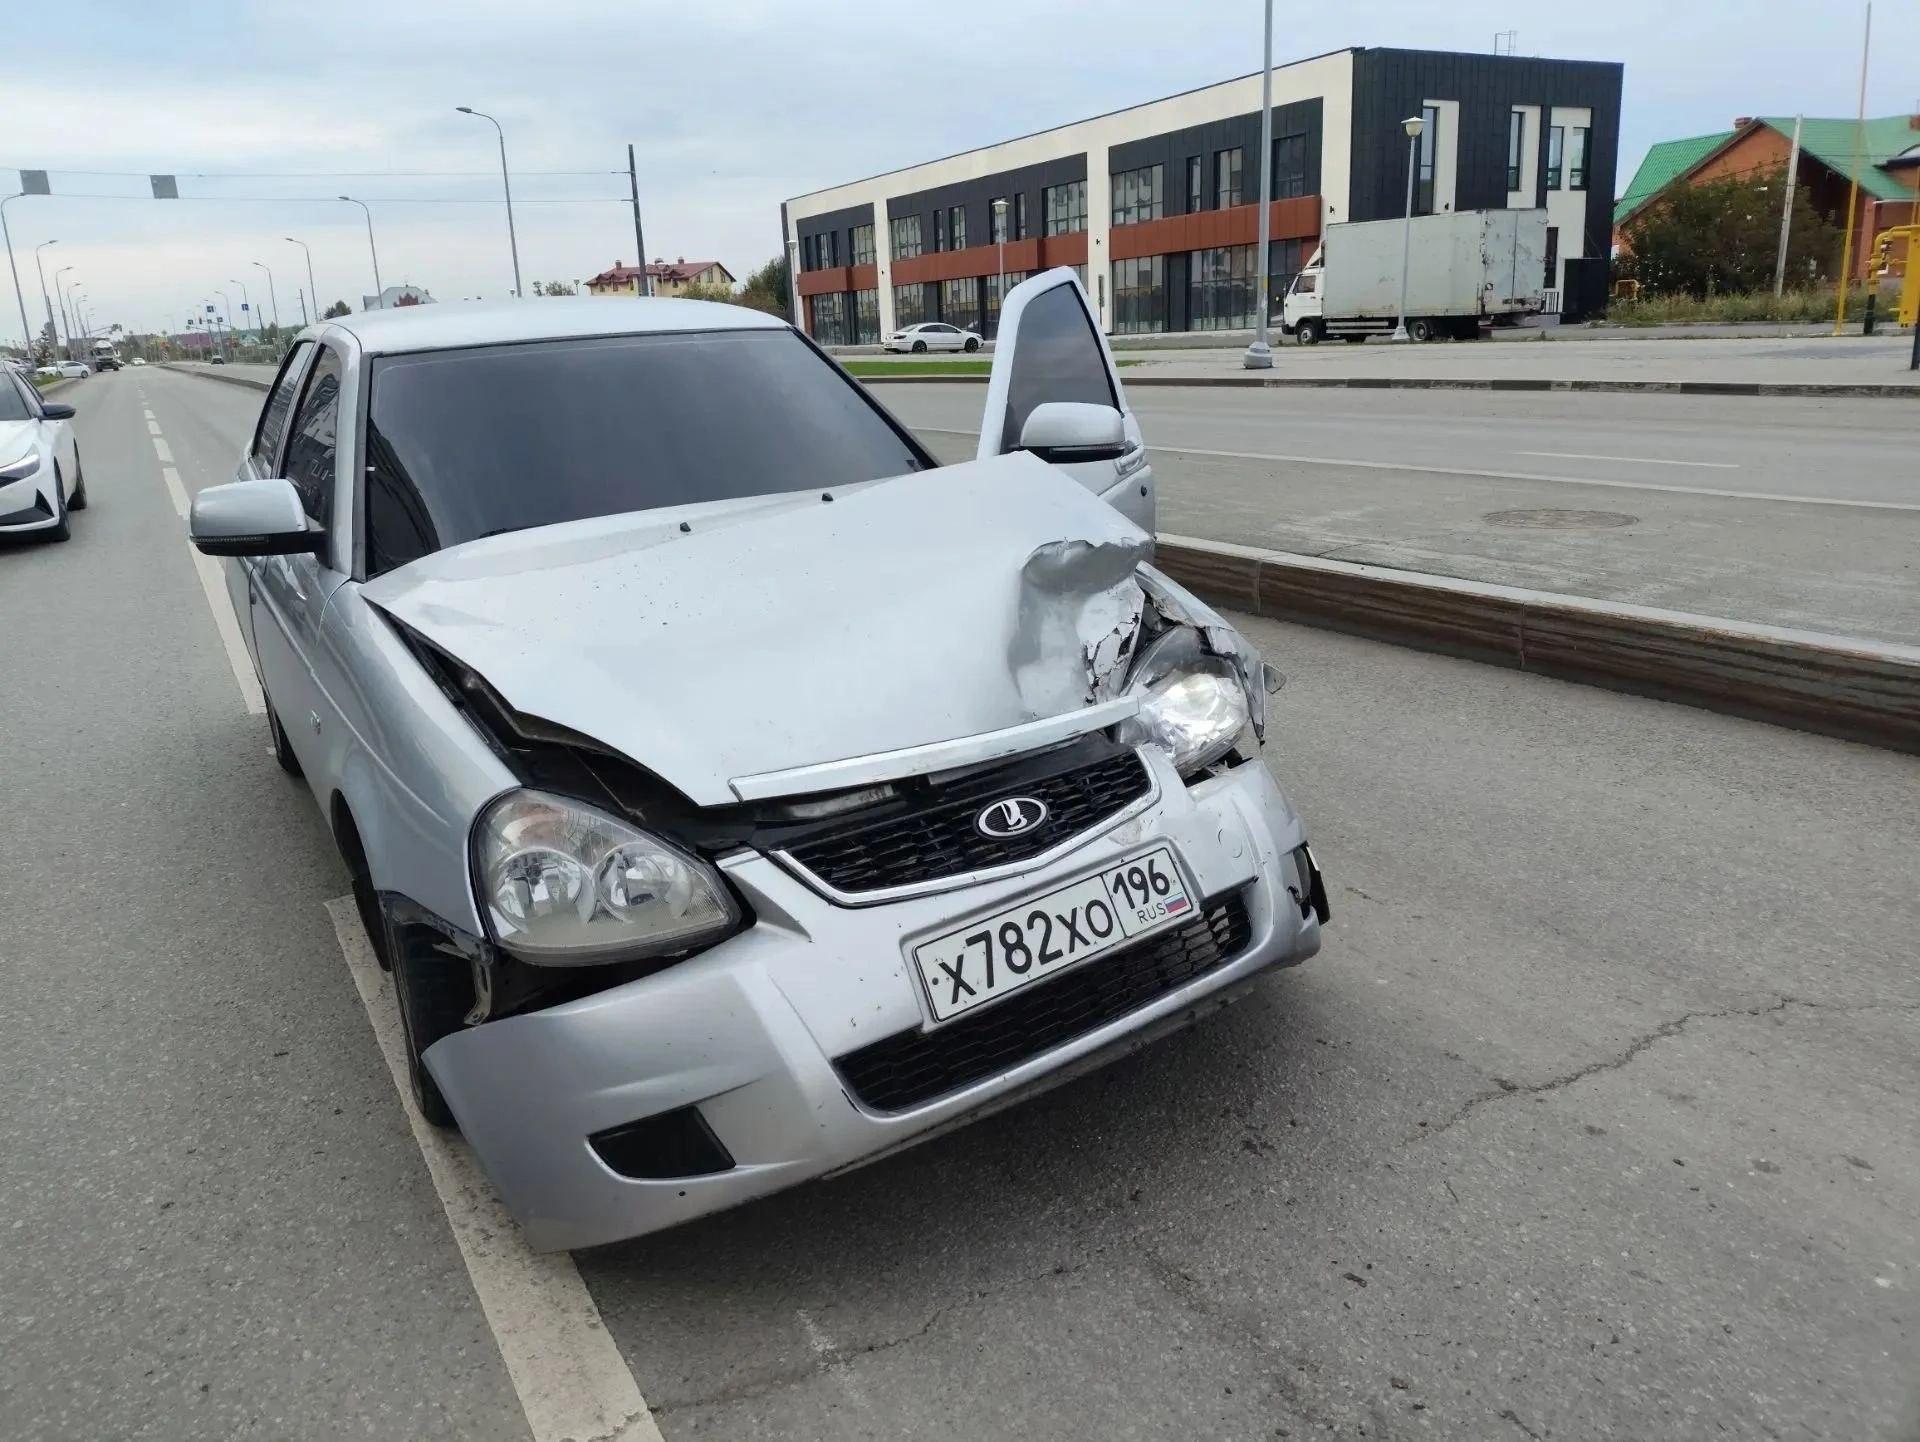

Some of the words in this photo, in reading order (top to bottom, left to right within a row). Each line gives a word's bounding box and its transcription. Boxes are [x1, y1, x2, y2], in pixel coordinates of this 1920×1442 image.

[939, 899, 1113, 1004] Х782ХО
[1112, 859, 1170, 910] 196
[1137, 902, 1166, 924] RUS
